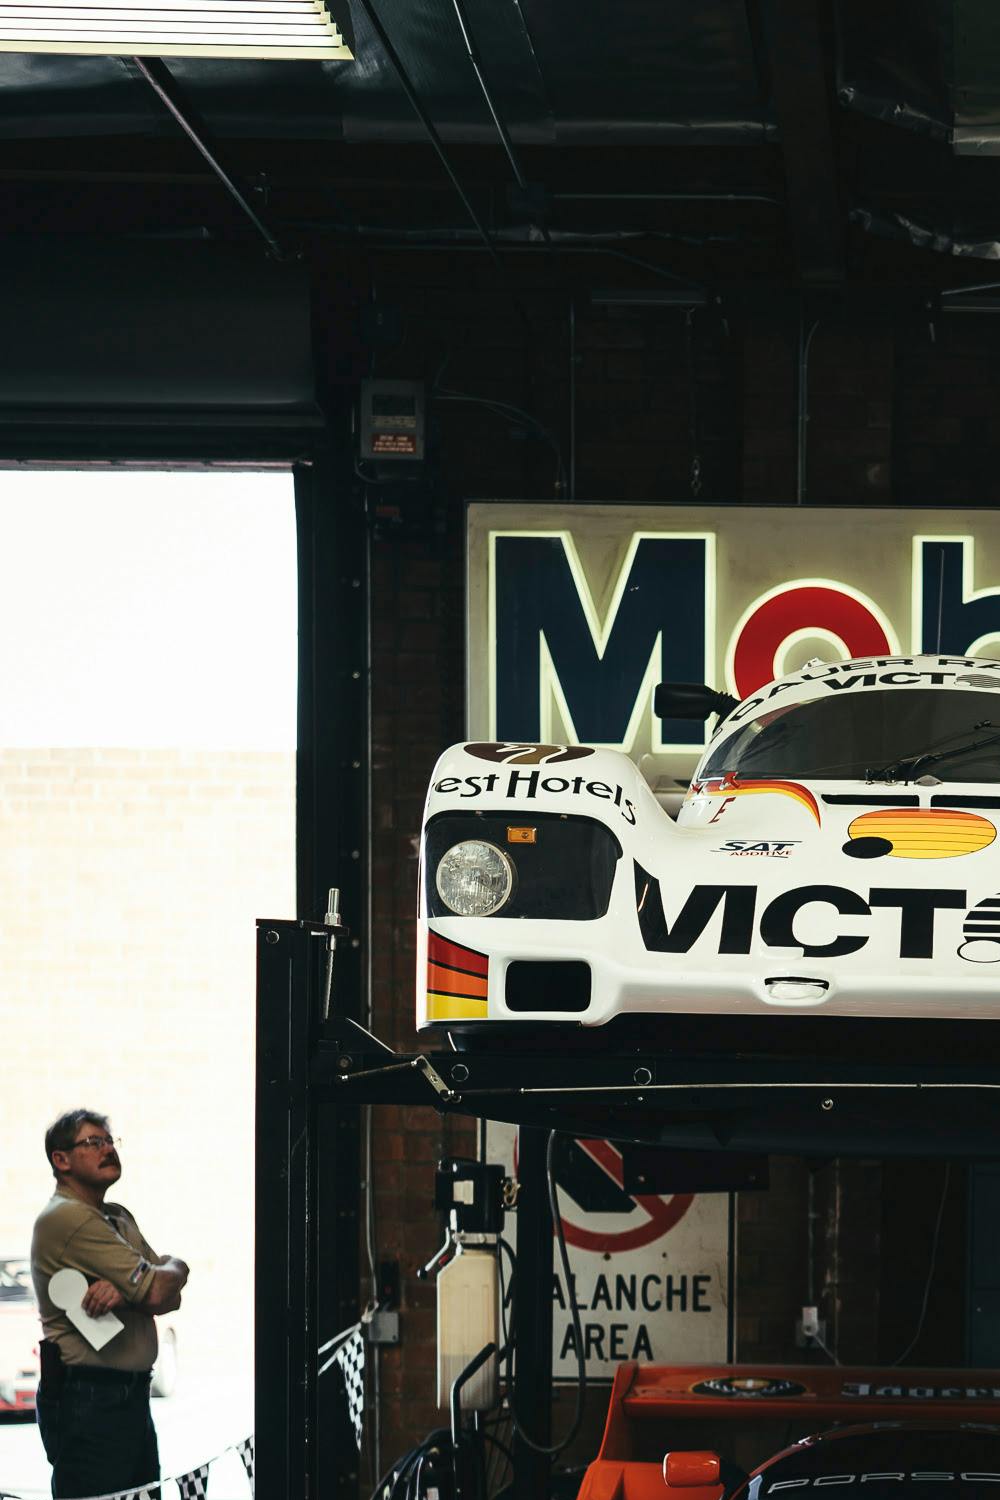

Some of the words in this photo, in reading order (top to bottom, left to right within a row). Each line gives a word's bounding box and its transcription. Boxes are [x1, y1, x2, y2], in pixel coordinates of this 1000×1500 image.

[730, 657, 914, 722] DAUER
[432, 773, 500, 798] est
[505, 770, 637, 826] Hotels
[719, 841, 795, 852] SAT
[552, 1274, 712, 1312] ALANCHE
[559, 1323, 654, 1361] AREA
